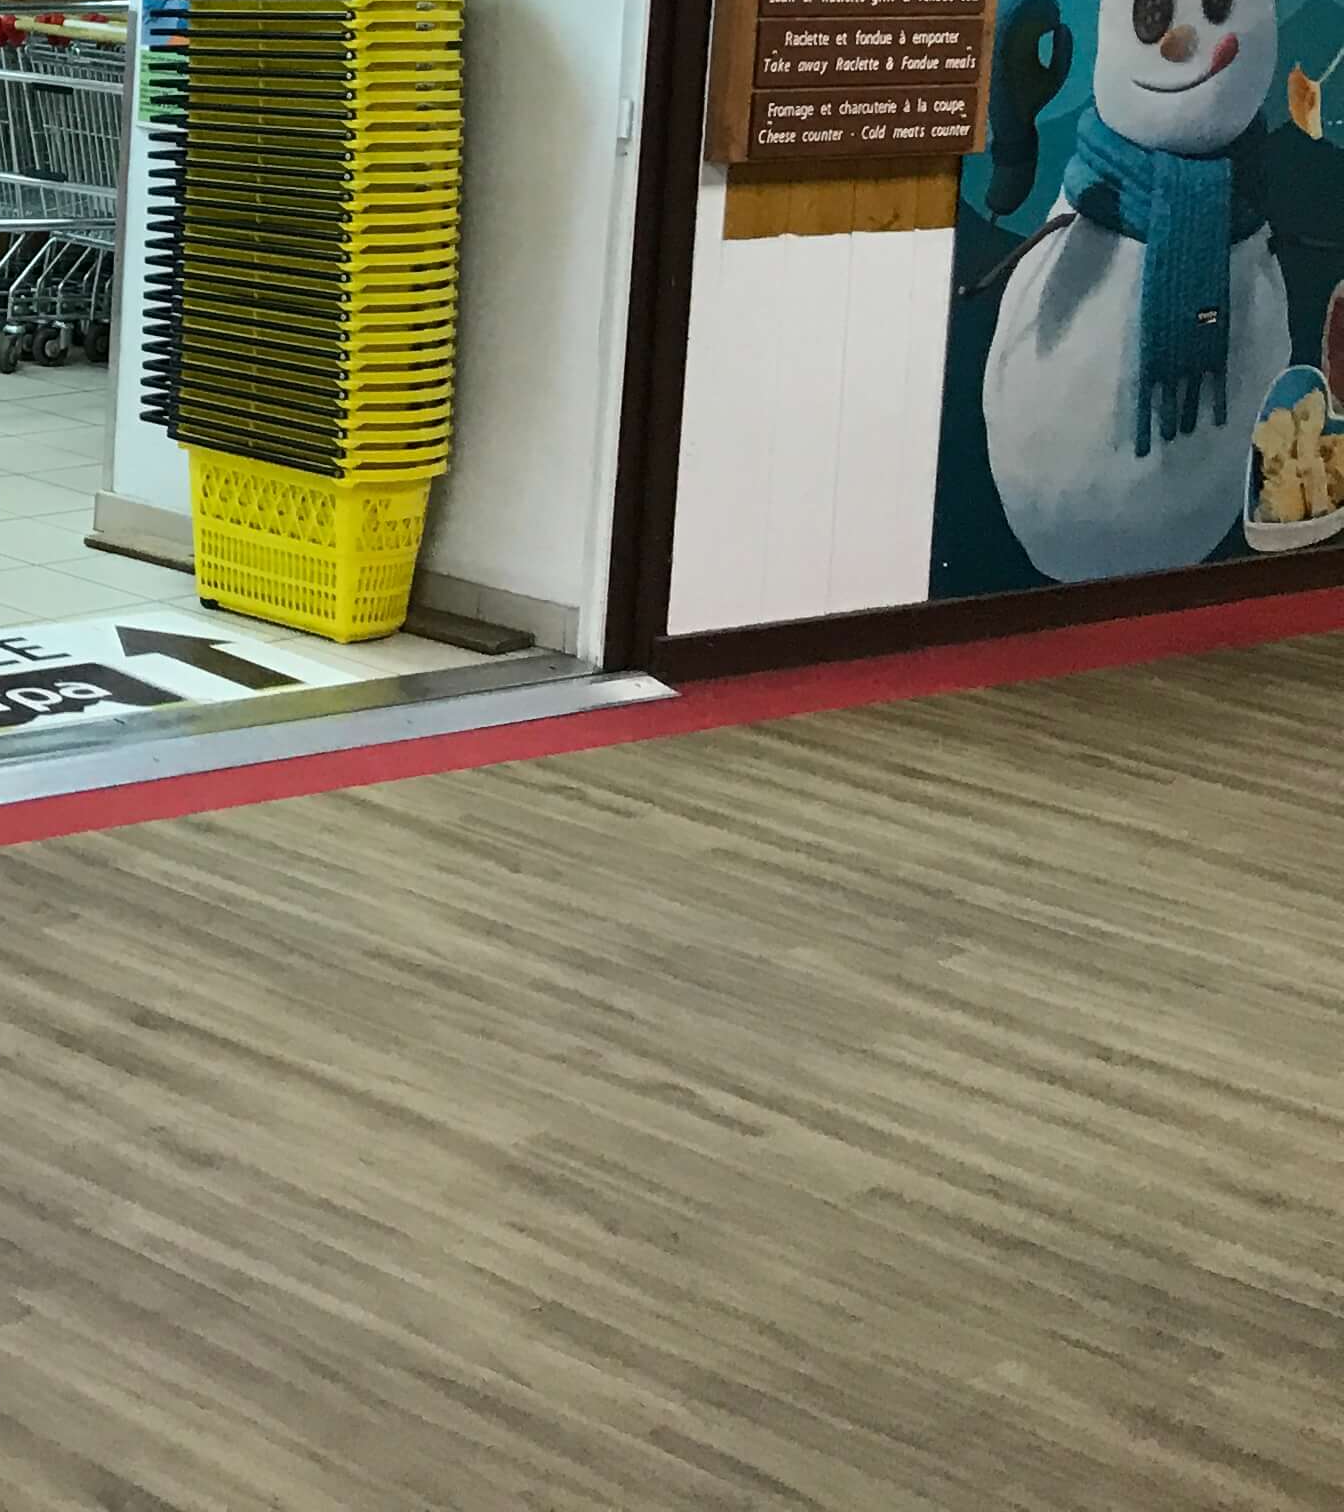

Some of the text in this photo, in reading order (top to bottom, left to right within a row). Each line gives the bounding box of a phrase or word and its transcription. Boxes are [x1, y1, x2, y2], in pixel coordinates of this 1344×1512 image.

[784, 29, 960, 48] Raclette et fondue à emporter
[763, 53, 976, 76] Take away Raclette & Fondue meals
[767, 97, 966, 121] Fromage et charcuterie à la coupe
[758, 128, 797, 145] Cheese
[801, 128, 844, 143] counter
[861, 124, 887, 141] Cold
[892, 124, 926, 140] meats
[930, 123, 972, 138] counter
